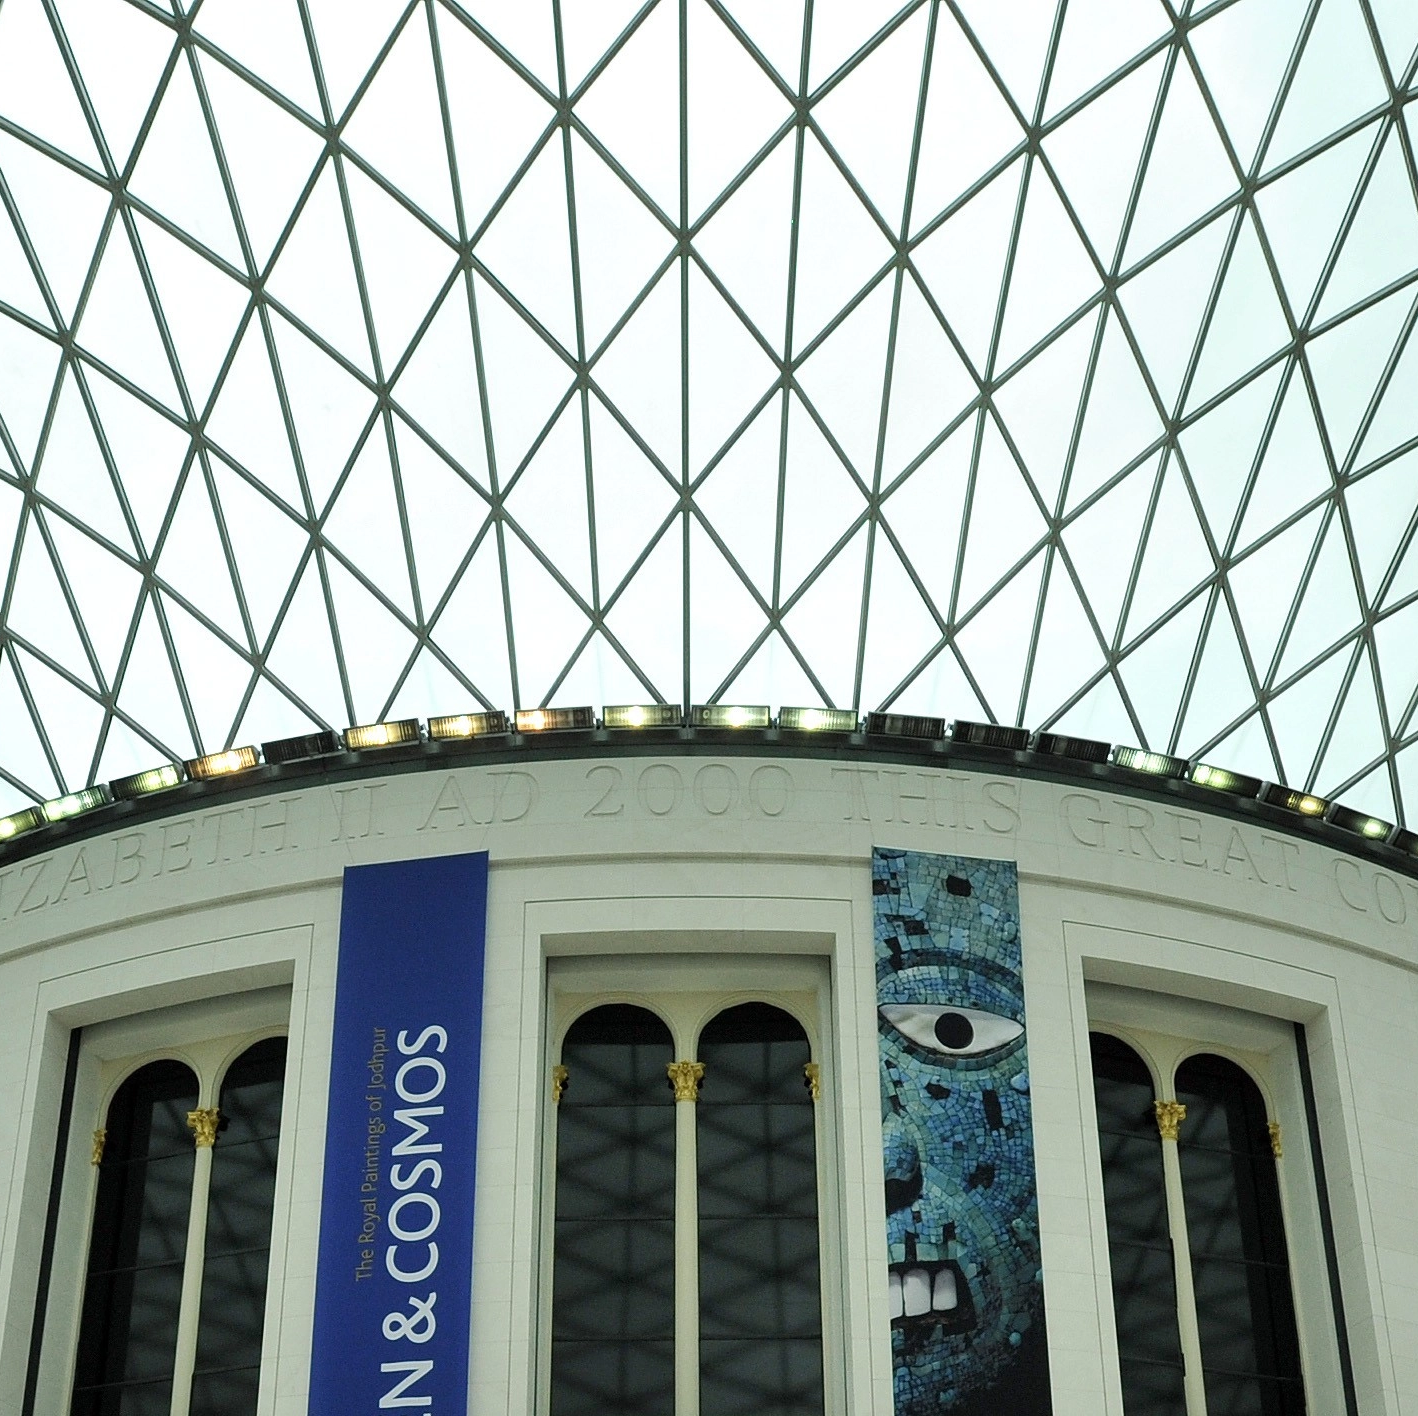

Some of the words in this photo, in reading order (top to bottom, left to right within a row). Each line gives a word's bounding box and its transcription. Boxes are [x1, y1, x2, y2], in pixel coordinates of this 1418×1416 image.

[331, 783, 388, 842] II
[416, 769, 542, 831] AD
[582, 763, 796, 820] 2000
[829, 766, 1022, 835] THIS
[1060, 792, 1303, 891] GREAT
[367, 1027, 389, 1089] Jodhpur
[365, 1095, 382, 1111] of
[361, 1117, 386, 1192] Paintings
[385, 1023, 449, 1283] COSMOS
[358, 1197, 381, 1242] Royal
[355, 1249, 374, 1281] The
[382, 1291, 439, 1344] &
